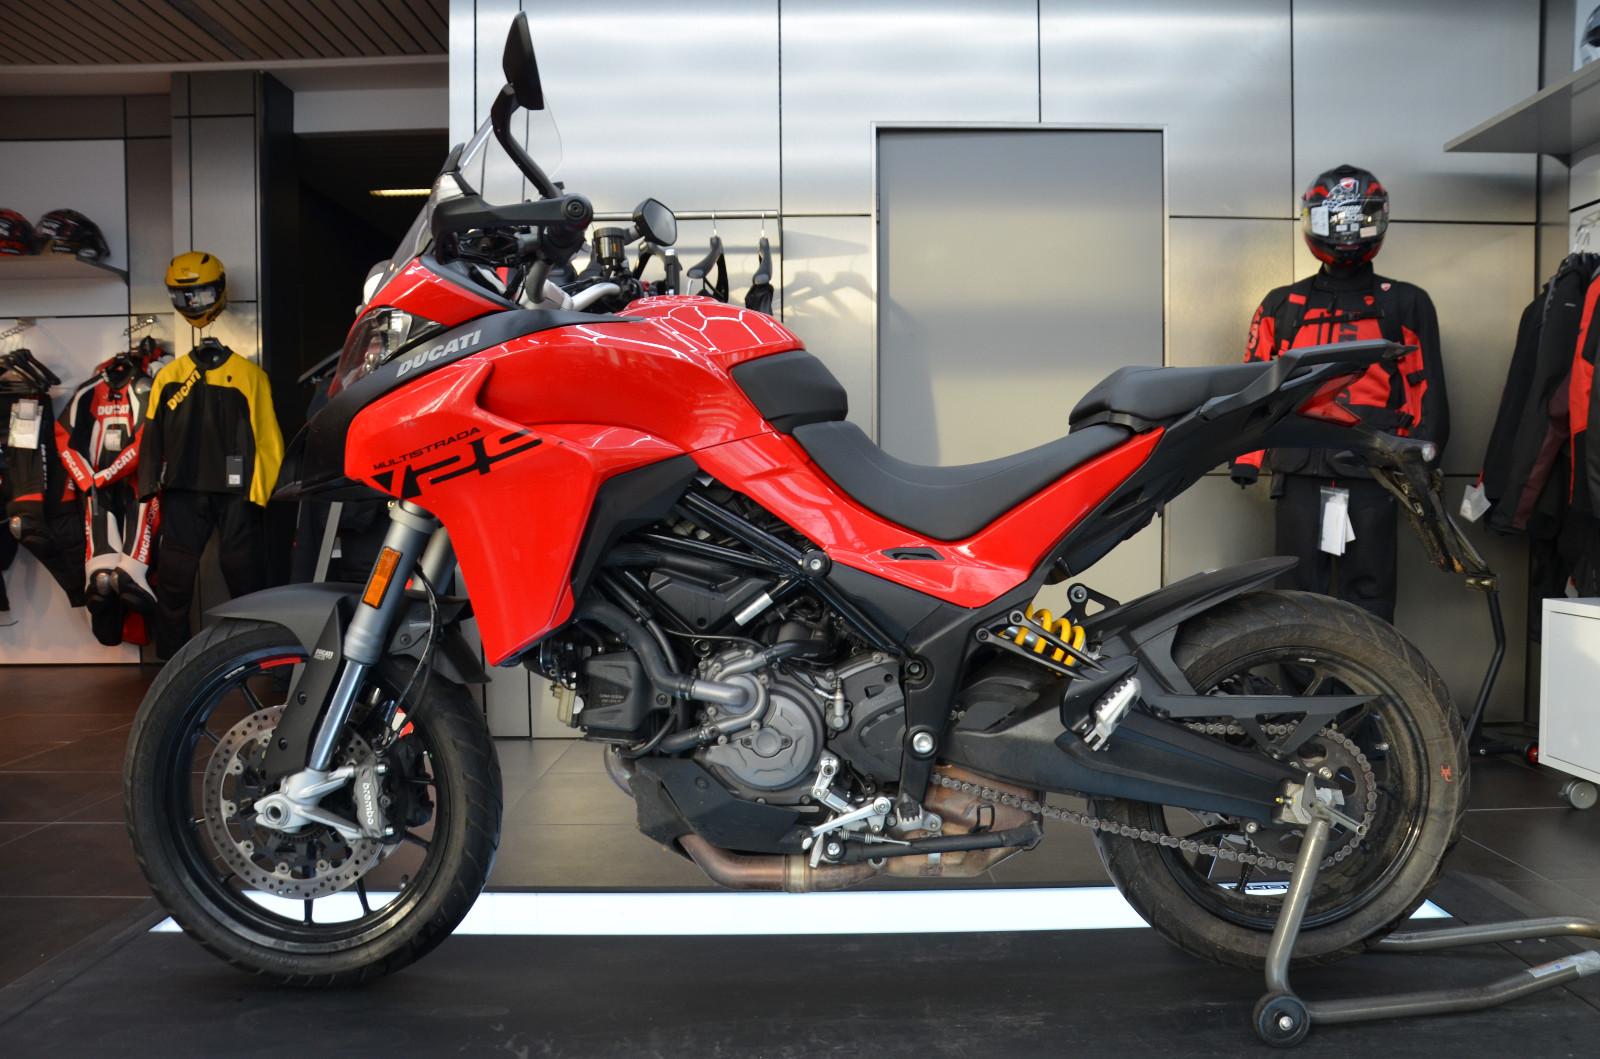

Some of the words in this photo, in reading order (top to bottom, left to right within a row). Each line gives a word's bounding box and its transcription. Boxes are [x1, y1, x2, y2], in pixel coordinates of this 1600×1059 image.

[396, 329, 482, 378] DUCATI
[167, 369, 201, 411] DUCATI
[62, 449, 85, 481] DUCATI
[104, 447, 136, 481] DUCATI
[373, 426, 481, 471] MULTISTRADA
[137, 524, 152, 563] DUCATI
[362, 782, 375, 825] brembo
